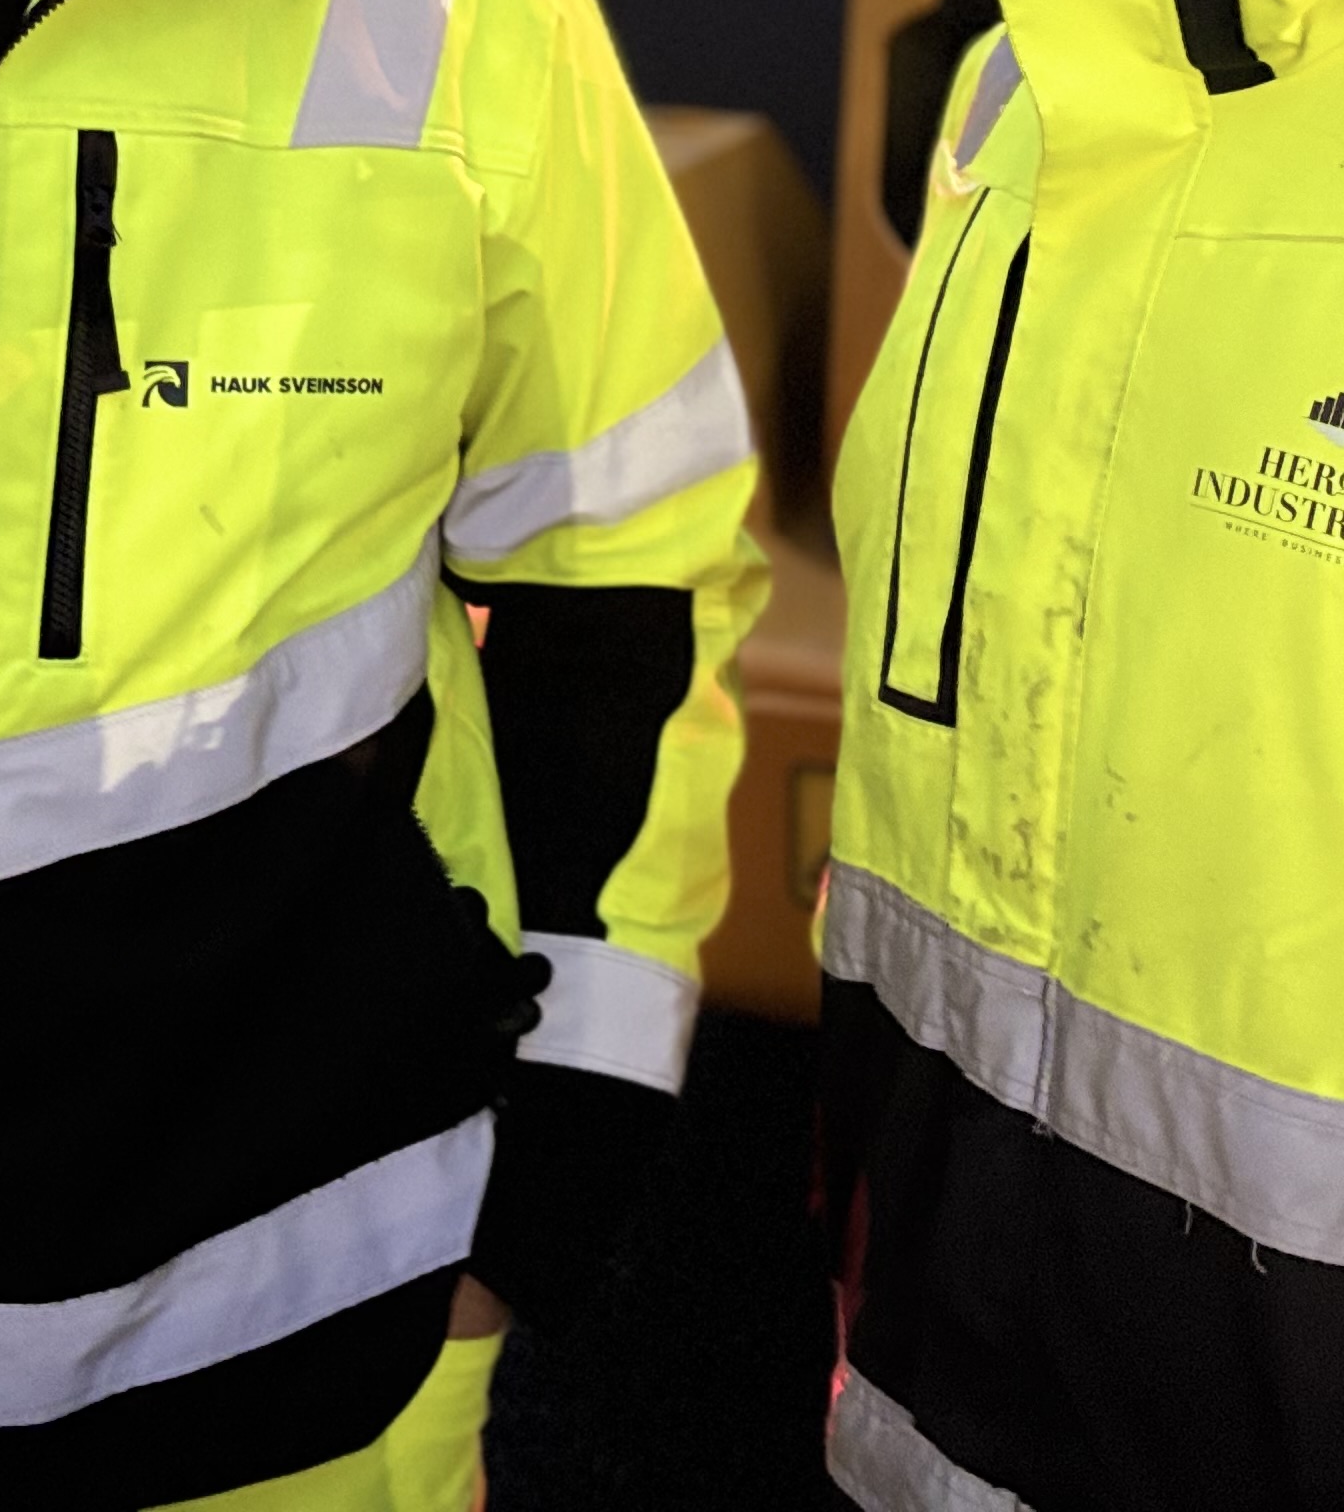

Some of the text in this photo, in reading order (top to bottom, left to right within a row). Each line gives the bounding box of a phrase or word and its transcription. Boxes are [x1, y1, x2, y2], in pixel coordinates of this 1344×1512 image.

[211, 376, 383, 394] HAUK SVEINSSON
[1224, 521, 1269, 542] WHERE
